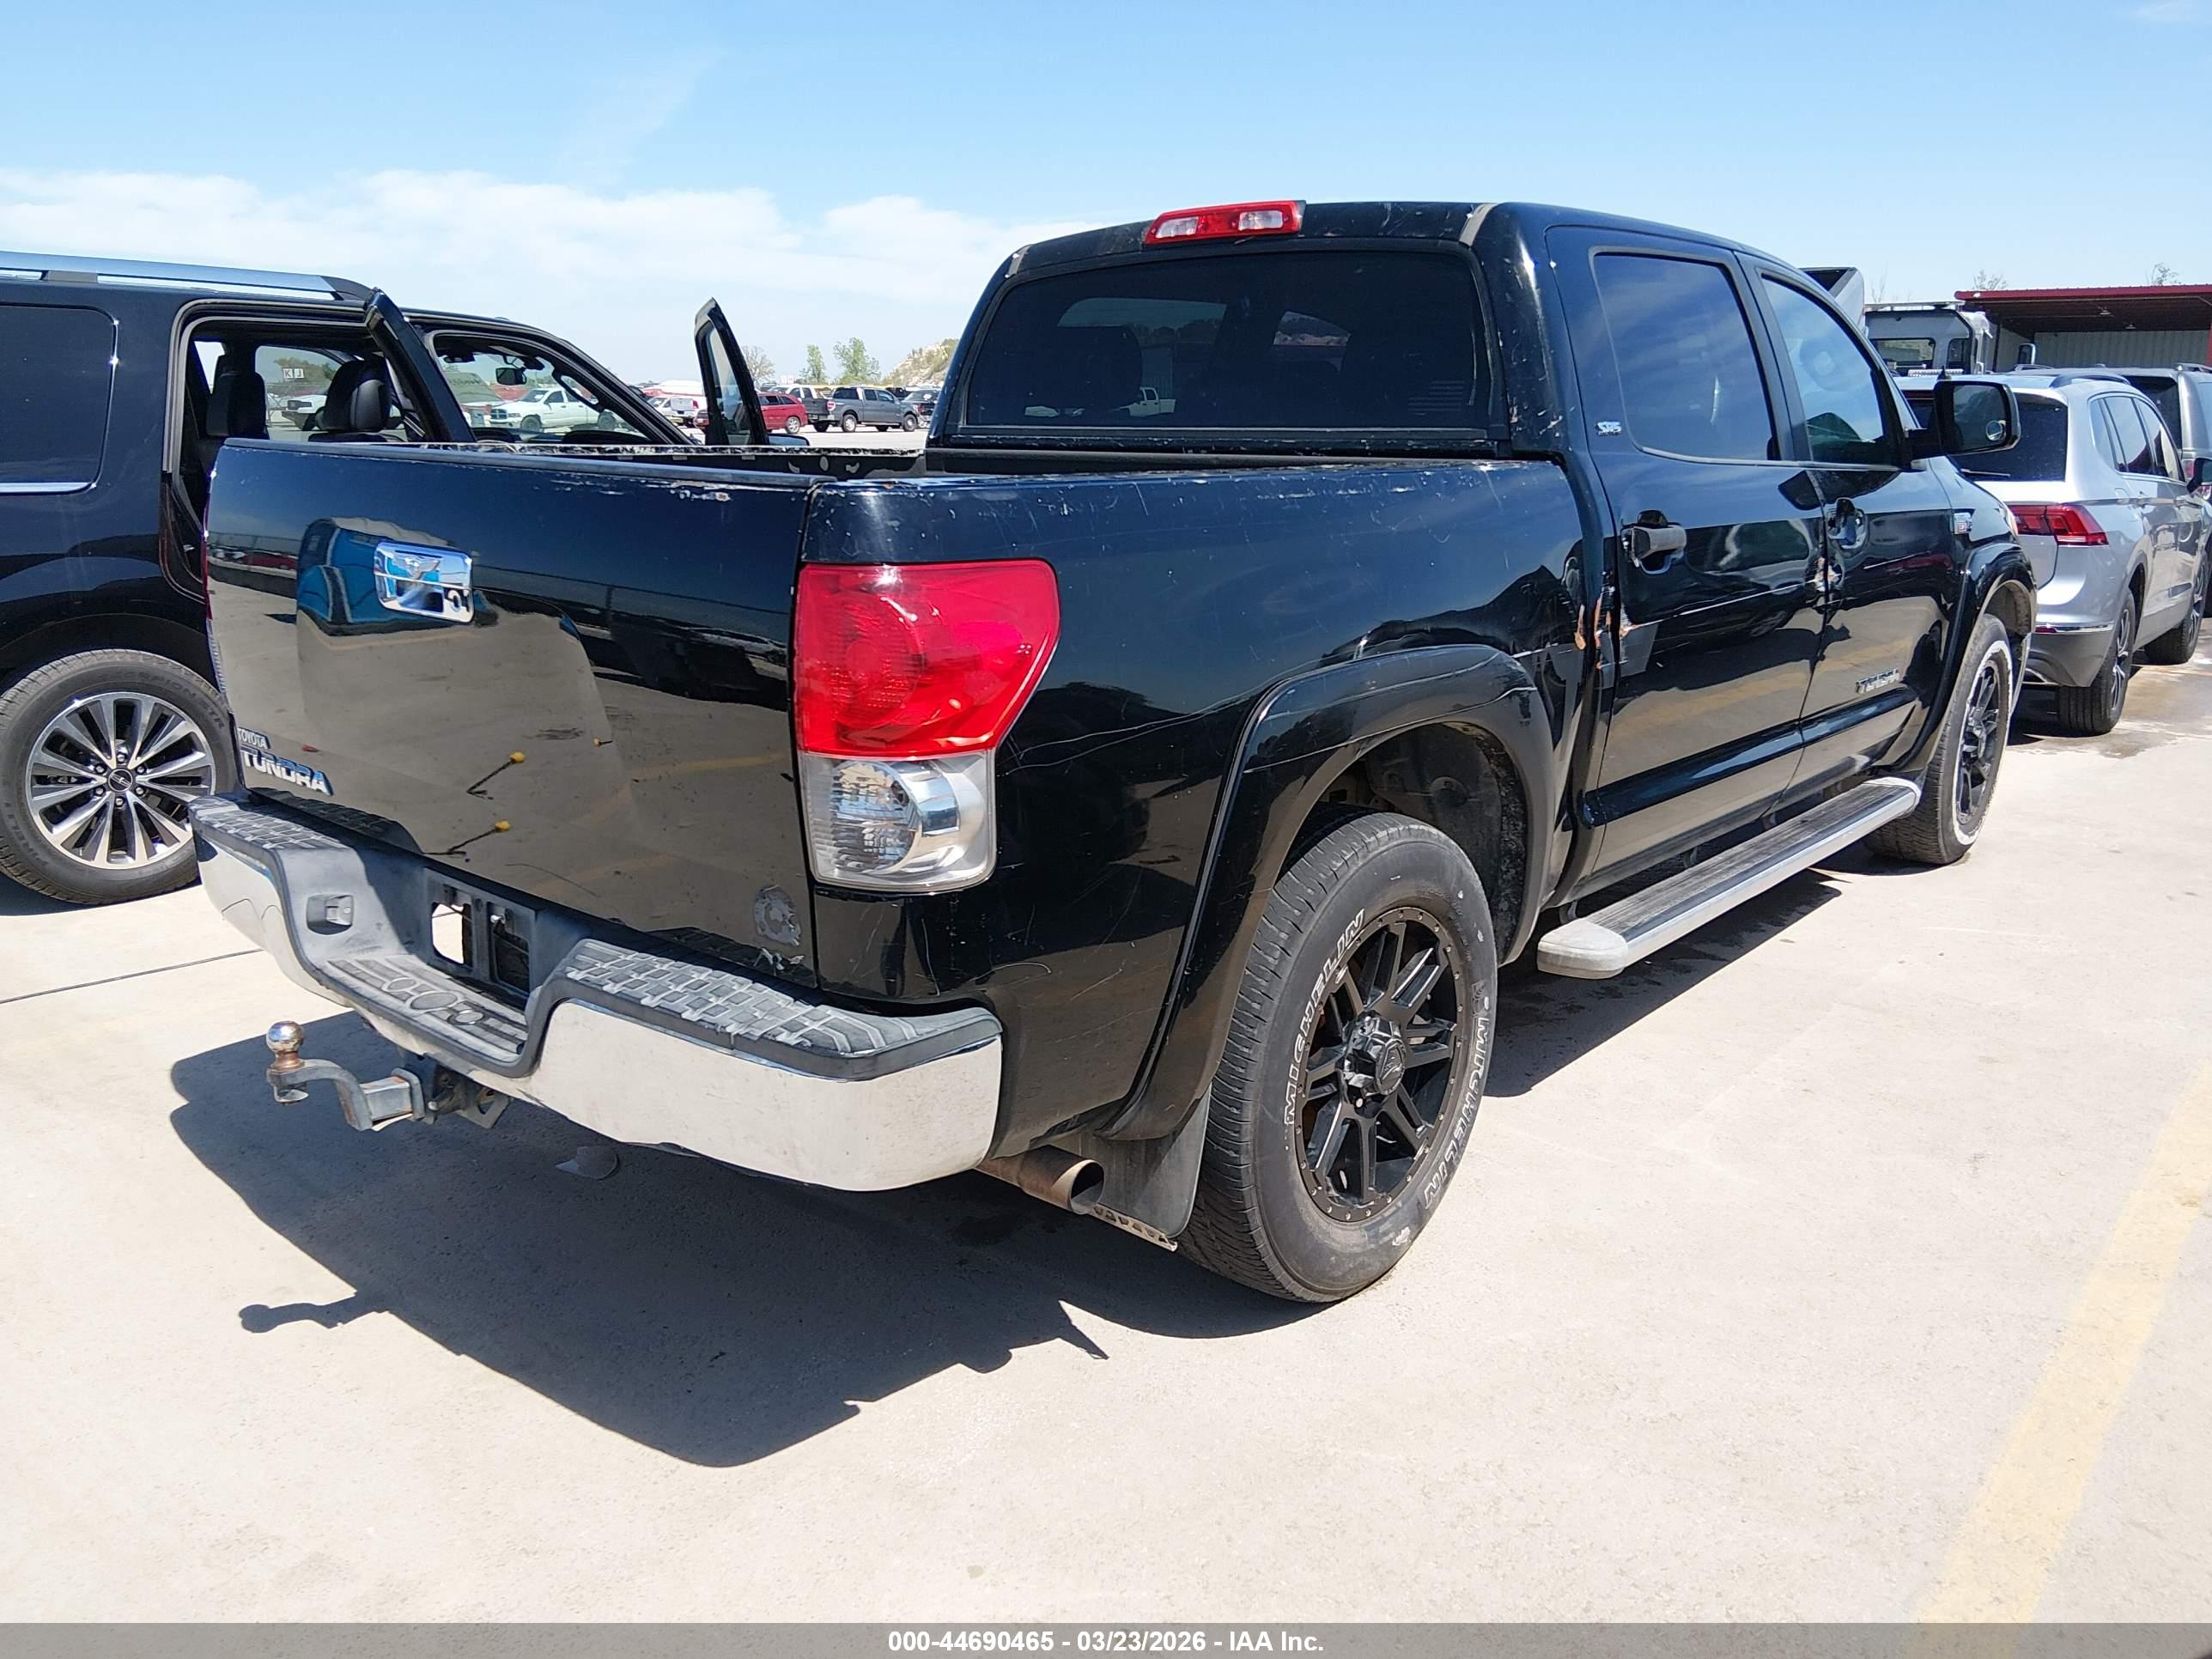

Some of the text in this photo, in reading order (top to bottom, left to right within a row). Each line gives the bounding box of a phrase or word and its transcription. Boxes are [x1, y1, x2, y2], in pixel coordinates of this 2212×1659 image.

[237, 727, 270, 749] TOYOTA
[240, 747, 333, 796] TUNDRA
[1285, 908, 1365, 1126] MICHELIN
[1425, 1016, 1489, 1209] MICHELIN
